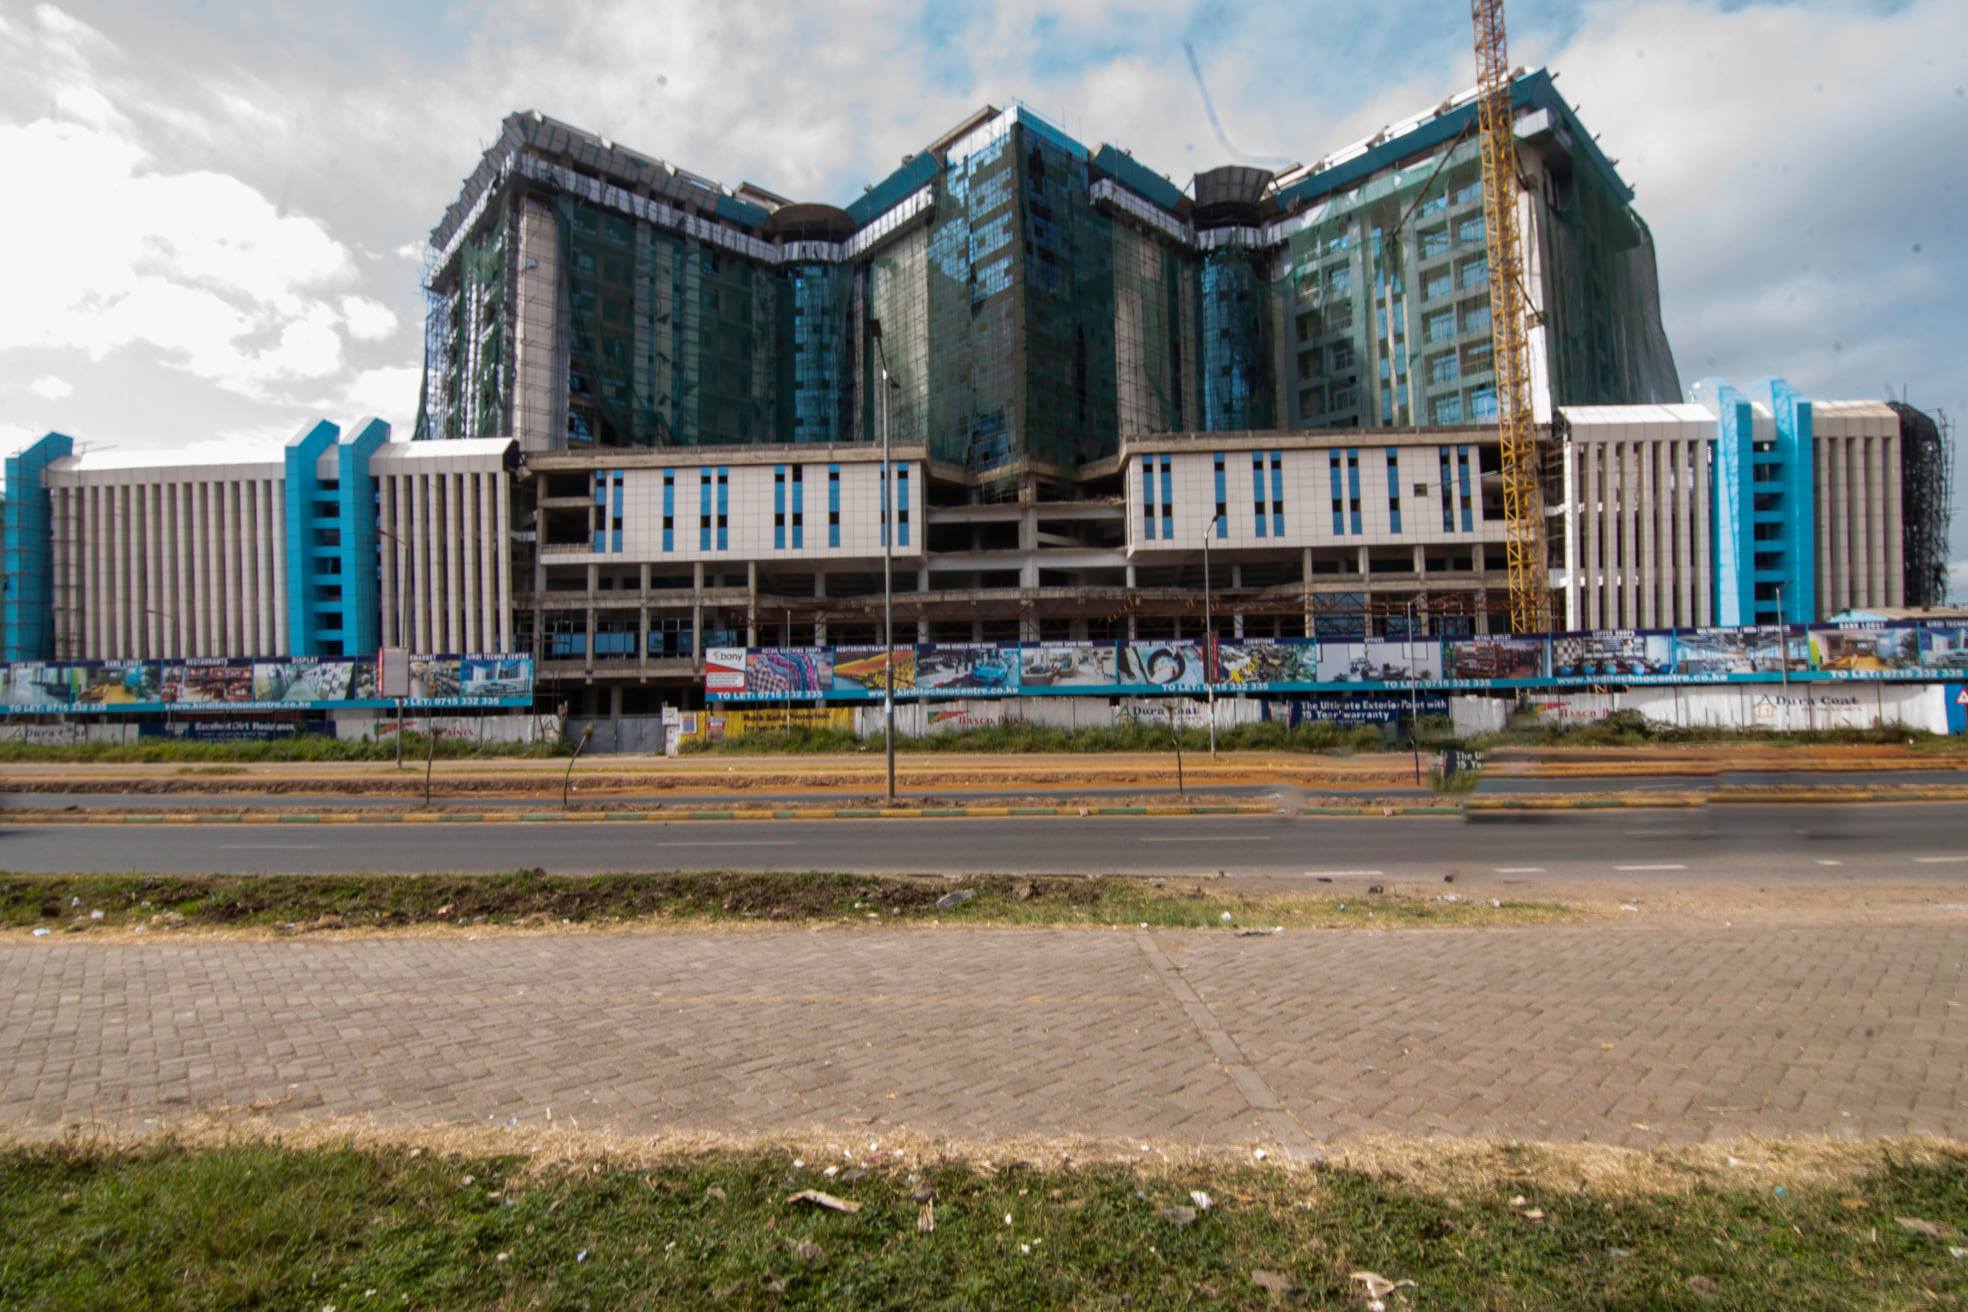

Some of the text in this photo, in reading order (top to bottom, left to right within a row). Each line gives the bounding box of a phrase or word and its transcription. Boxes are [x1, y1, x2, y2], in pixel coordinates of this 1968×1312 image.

[1161, 683, 1175, 692] TO
[1231, 682, 1248, 690] 332
[1251, 682, 1269, 690] 335
[1383, 681, 1398, 689] TO
[1453, 679, 1470, 687] 332
[1473, 679, 1491, 687] 335
[717, 691, 731, 700] TO
[784, 690, 802, 699] 332
[805, 690, 823, 698] 335
[868, 686, 1019, 697] ww.kirditechnocentre.co.ke
[461, 697, 479, 705] 332
[481, 696, 499, 705] 335
[1302, 701, 1317, 710] The
[1427, 699, 1447, 709] with
[1132, 706, 1165, 716] Dura
[1343, 711, 1389, 722] warranty
